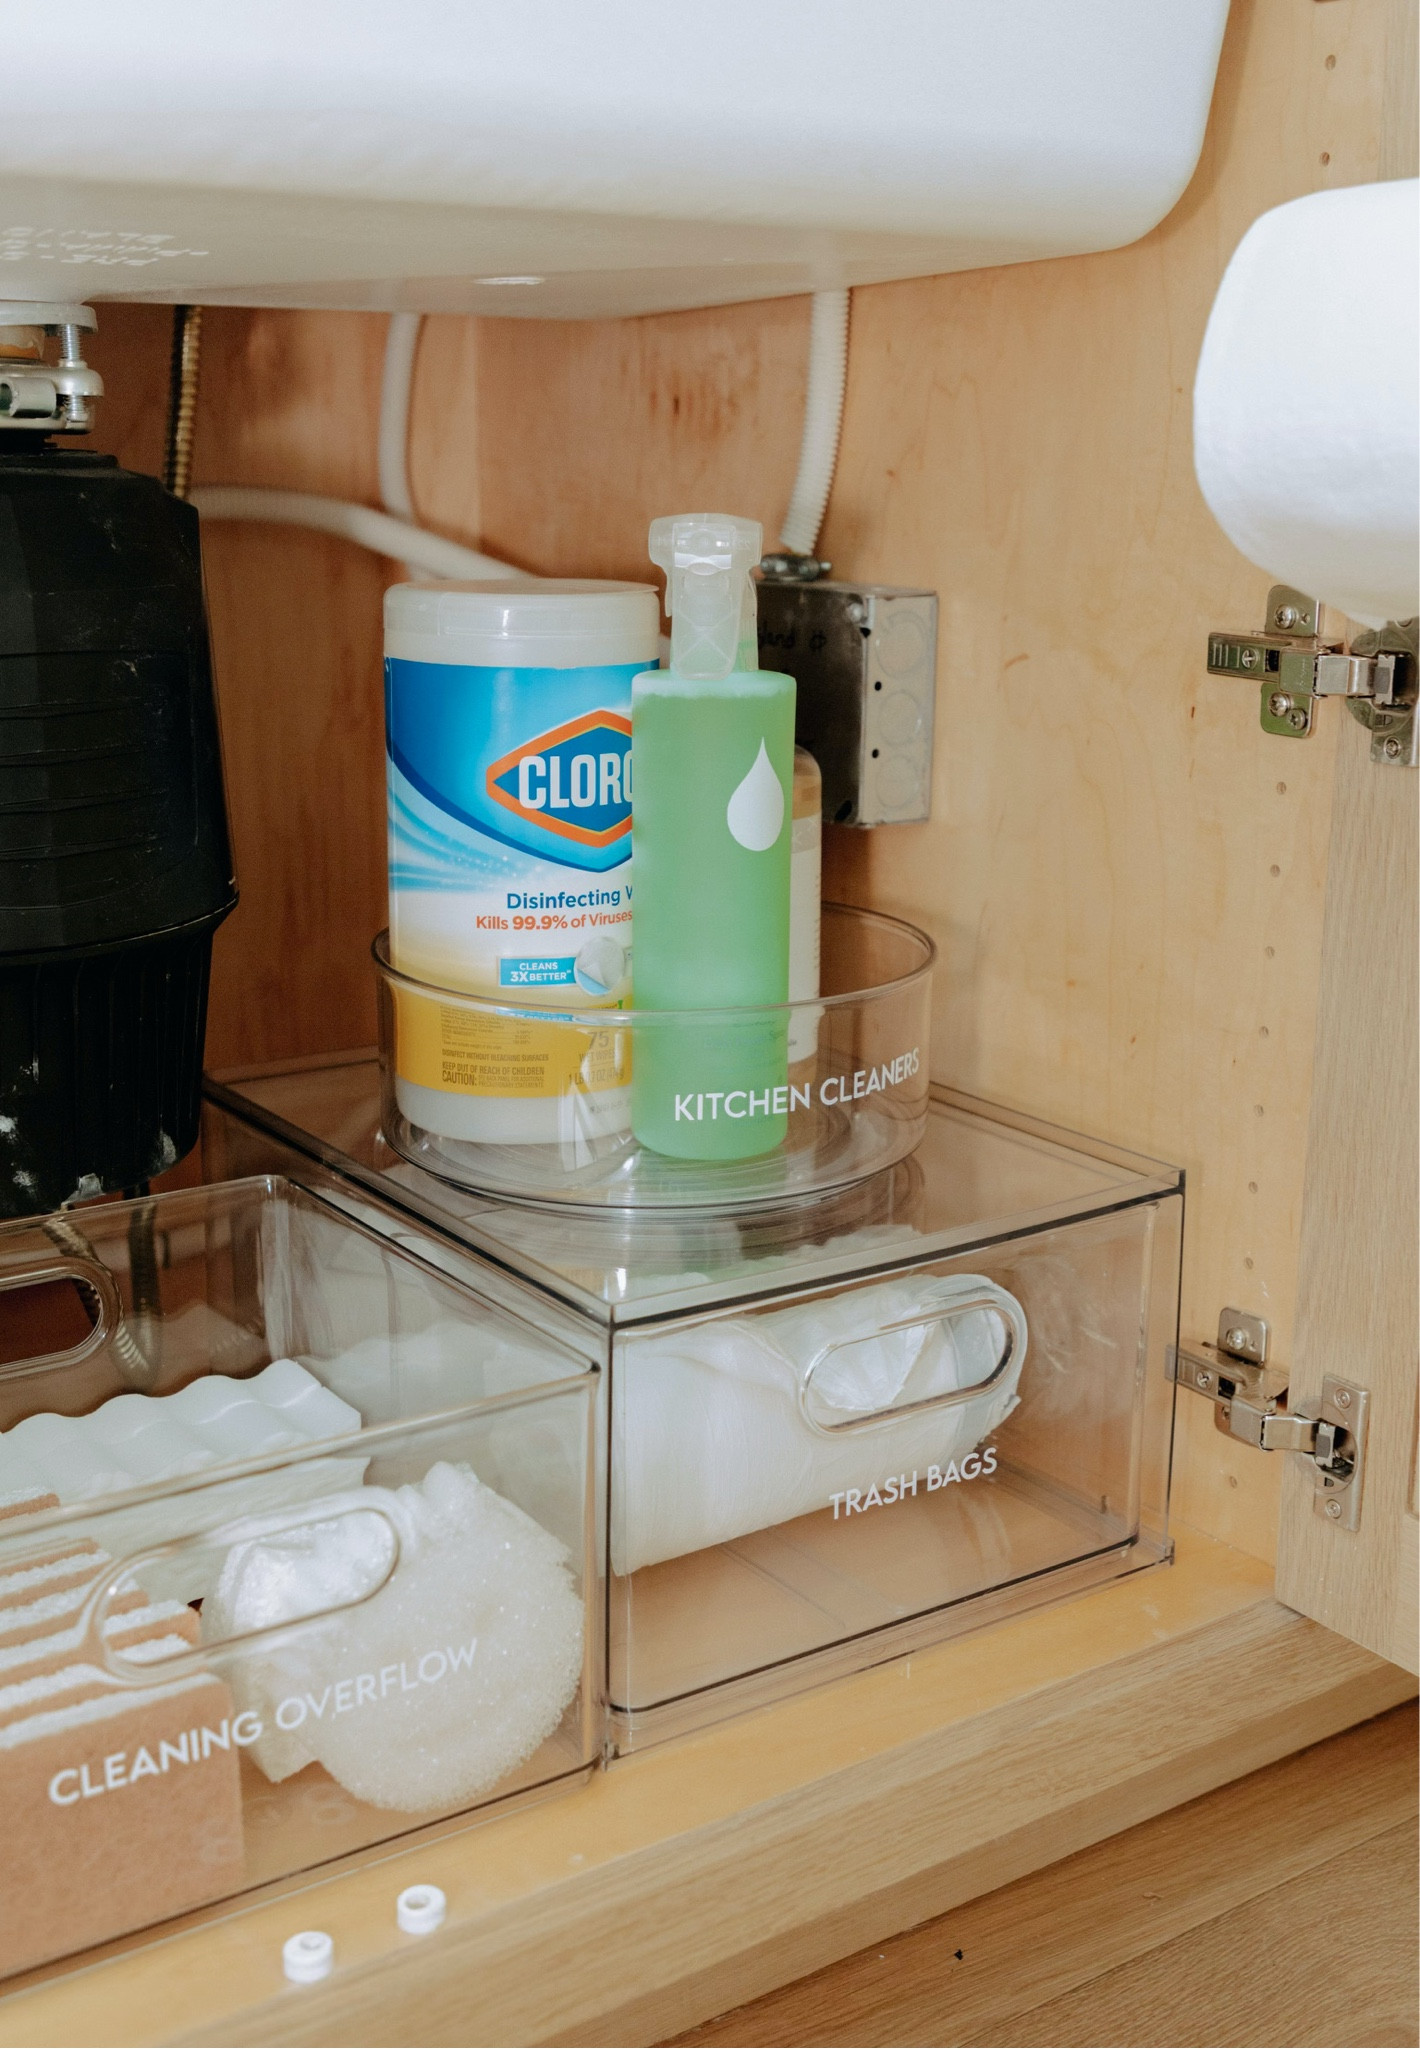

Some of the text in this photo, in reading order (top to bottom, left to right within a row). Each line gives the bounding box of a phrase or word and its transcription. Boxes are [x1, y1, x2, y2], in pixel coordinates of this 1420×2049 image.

[507, 889, 621, 909] Disinfecting
[476, 910, 632, 930] Kills 99.9% of Viruses
[519, 962, 558, 971] CLEANS
[510, 971, 529, 982] 3X
[587, 1031, 610, 1049] 75
[466, 1051, 490, 1061] WITHOUT
[521, 1053, 549, 1062] SURFACES
[442, 1061, 545, 1076] KEEP OUT OF REACH OF CHILDREN
[442, 1070, 477, 1086] CAUTION:
[675, 1047, 920, 1121] KITCHEN CLEANERS
[829, 1447, 998, 1520] TRASH BAGS
[47, 1638, 478, 1807] CLEANING OVERFLOW
